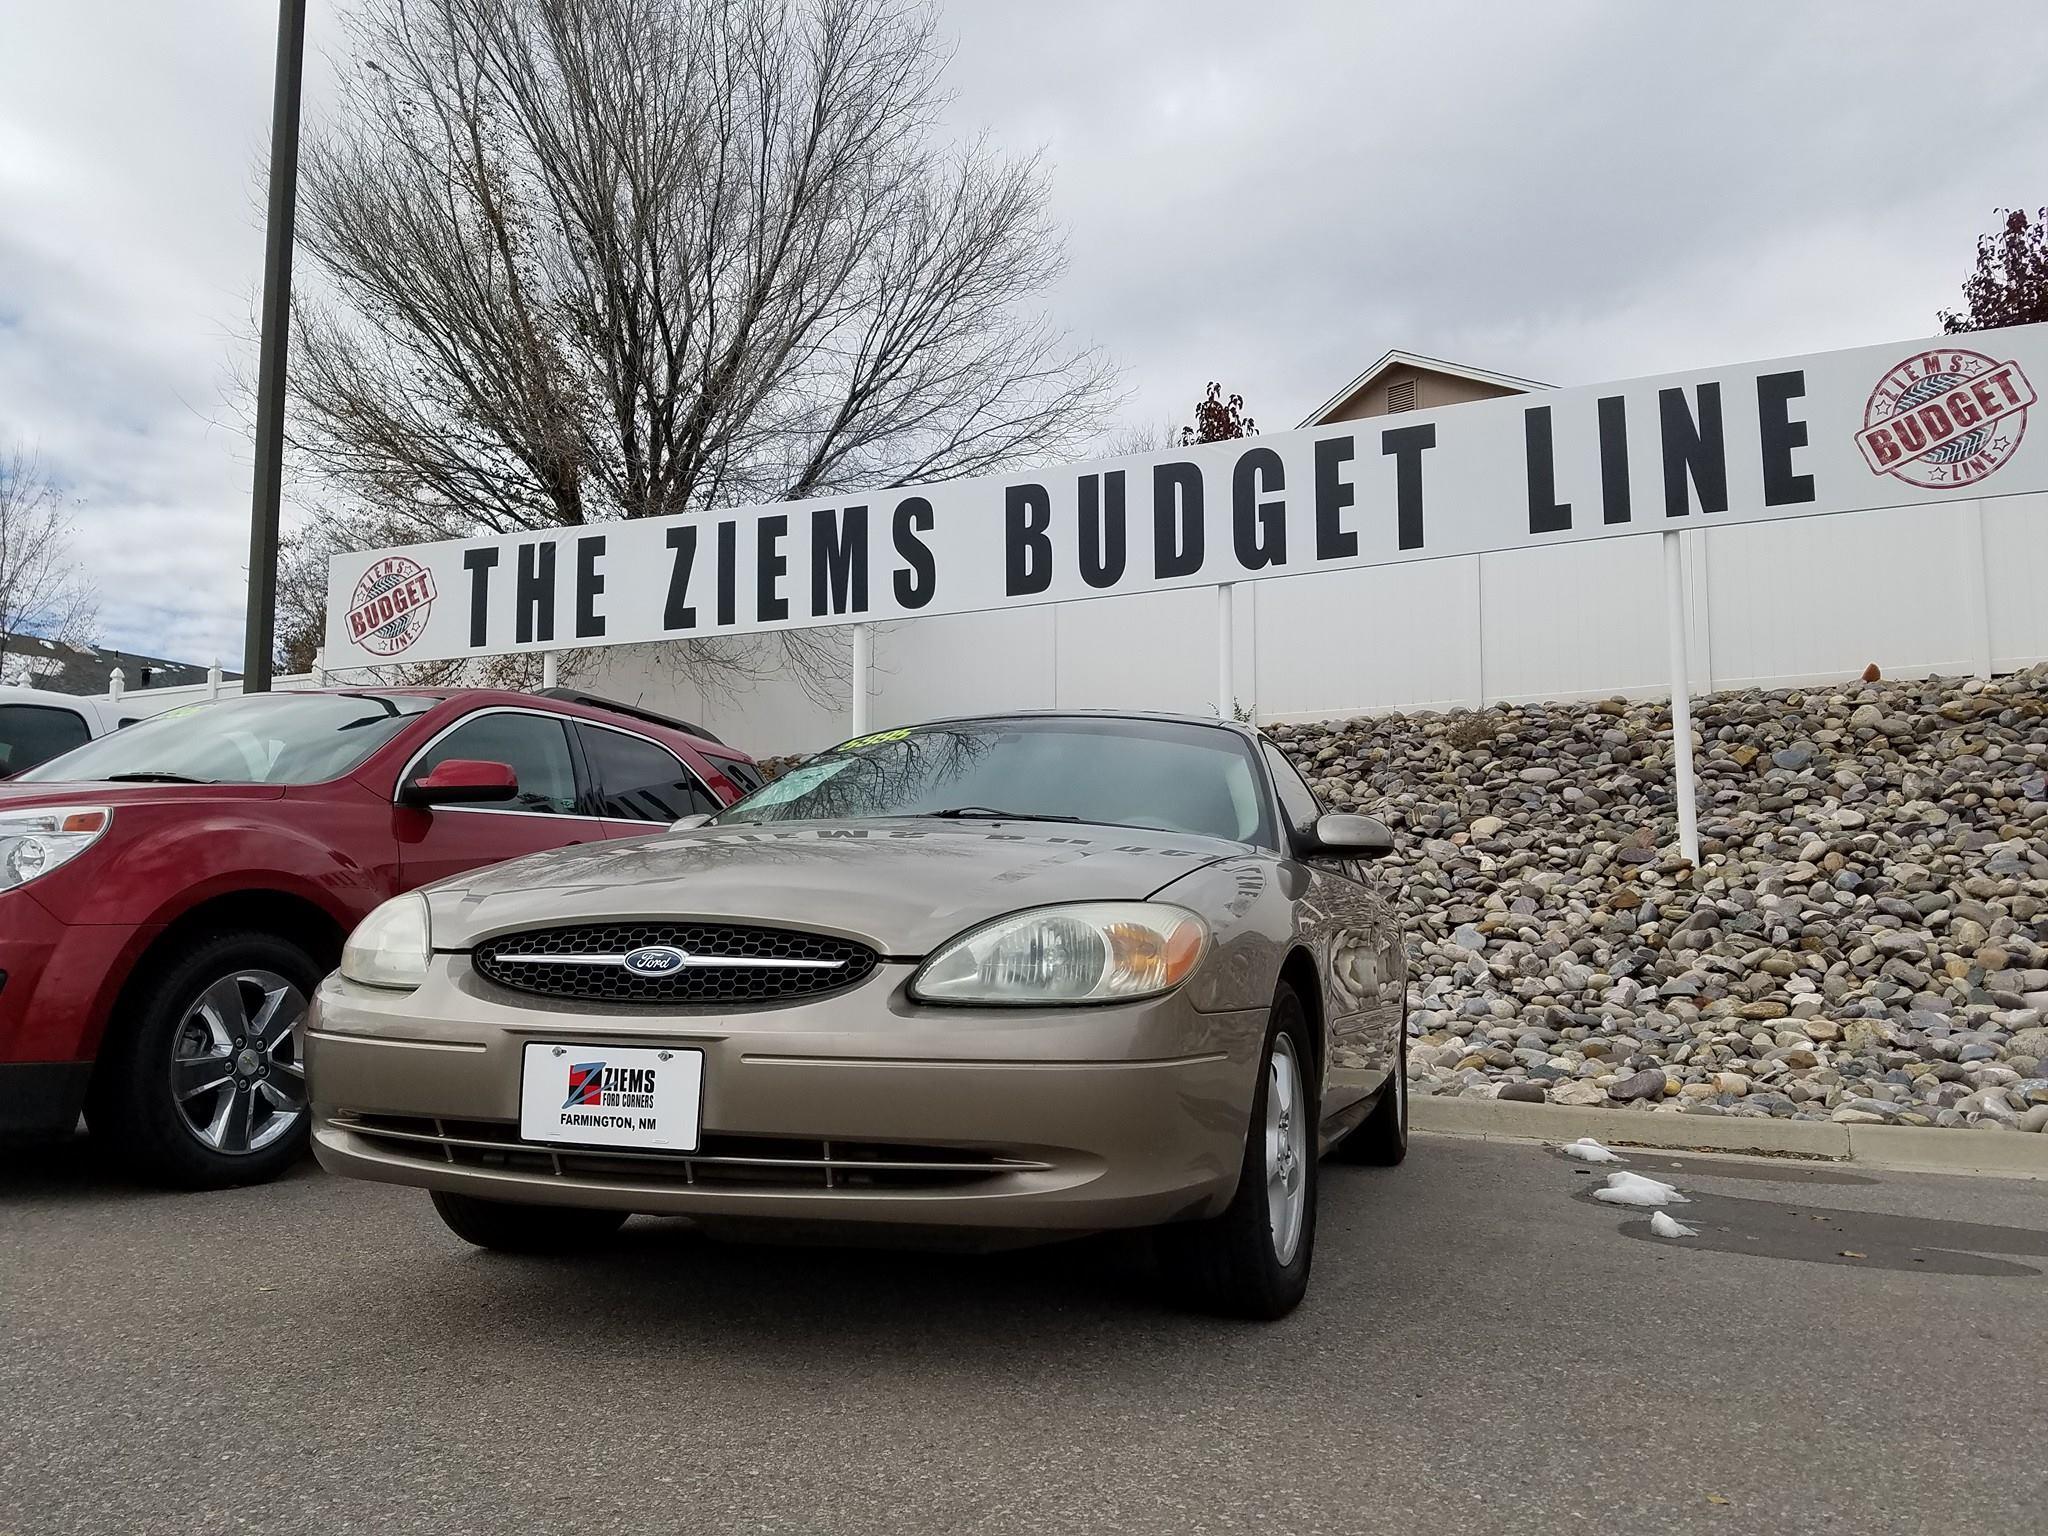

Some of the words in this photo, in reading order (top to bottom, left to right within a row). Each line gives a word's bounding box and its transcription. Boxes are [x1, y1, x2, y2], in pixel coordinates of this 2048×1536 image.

[1879, 355, 1963, 402] ZIEMS
[1866, 368, 2022, 467] BUDGET
[1952, 450, 1997, 481] LINE
[464, 536, 606, 648] THE
[663, 497, 936, 630] ZIEMS
[1005, 423, 1437, 597] BUDGET
[1525, 370, 1816, 535] LINE
[360, 561, 405, 593] ZIEMS
[350, 573, 430, 638] BUDGET
[389, 630, 414, 651] LINE
[637, 953, 672, 969] Ford
[603, 1067, 656, 1094] ZIEMS
[603, 1093, 620, 1107] FORD
[622, 1094, 654, 1109] CORNERS
[560, 1113, 636, 1132] FARMINGTON,
[638, 1118, 657, 1130] NM
